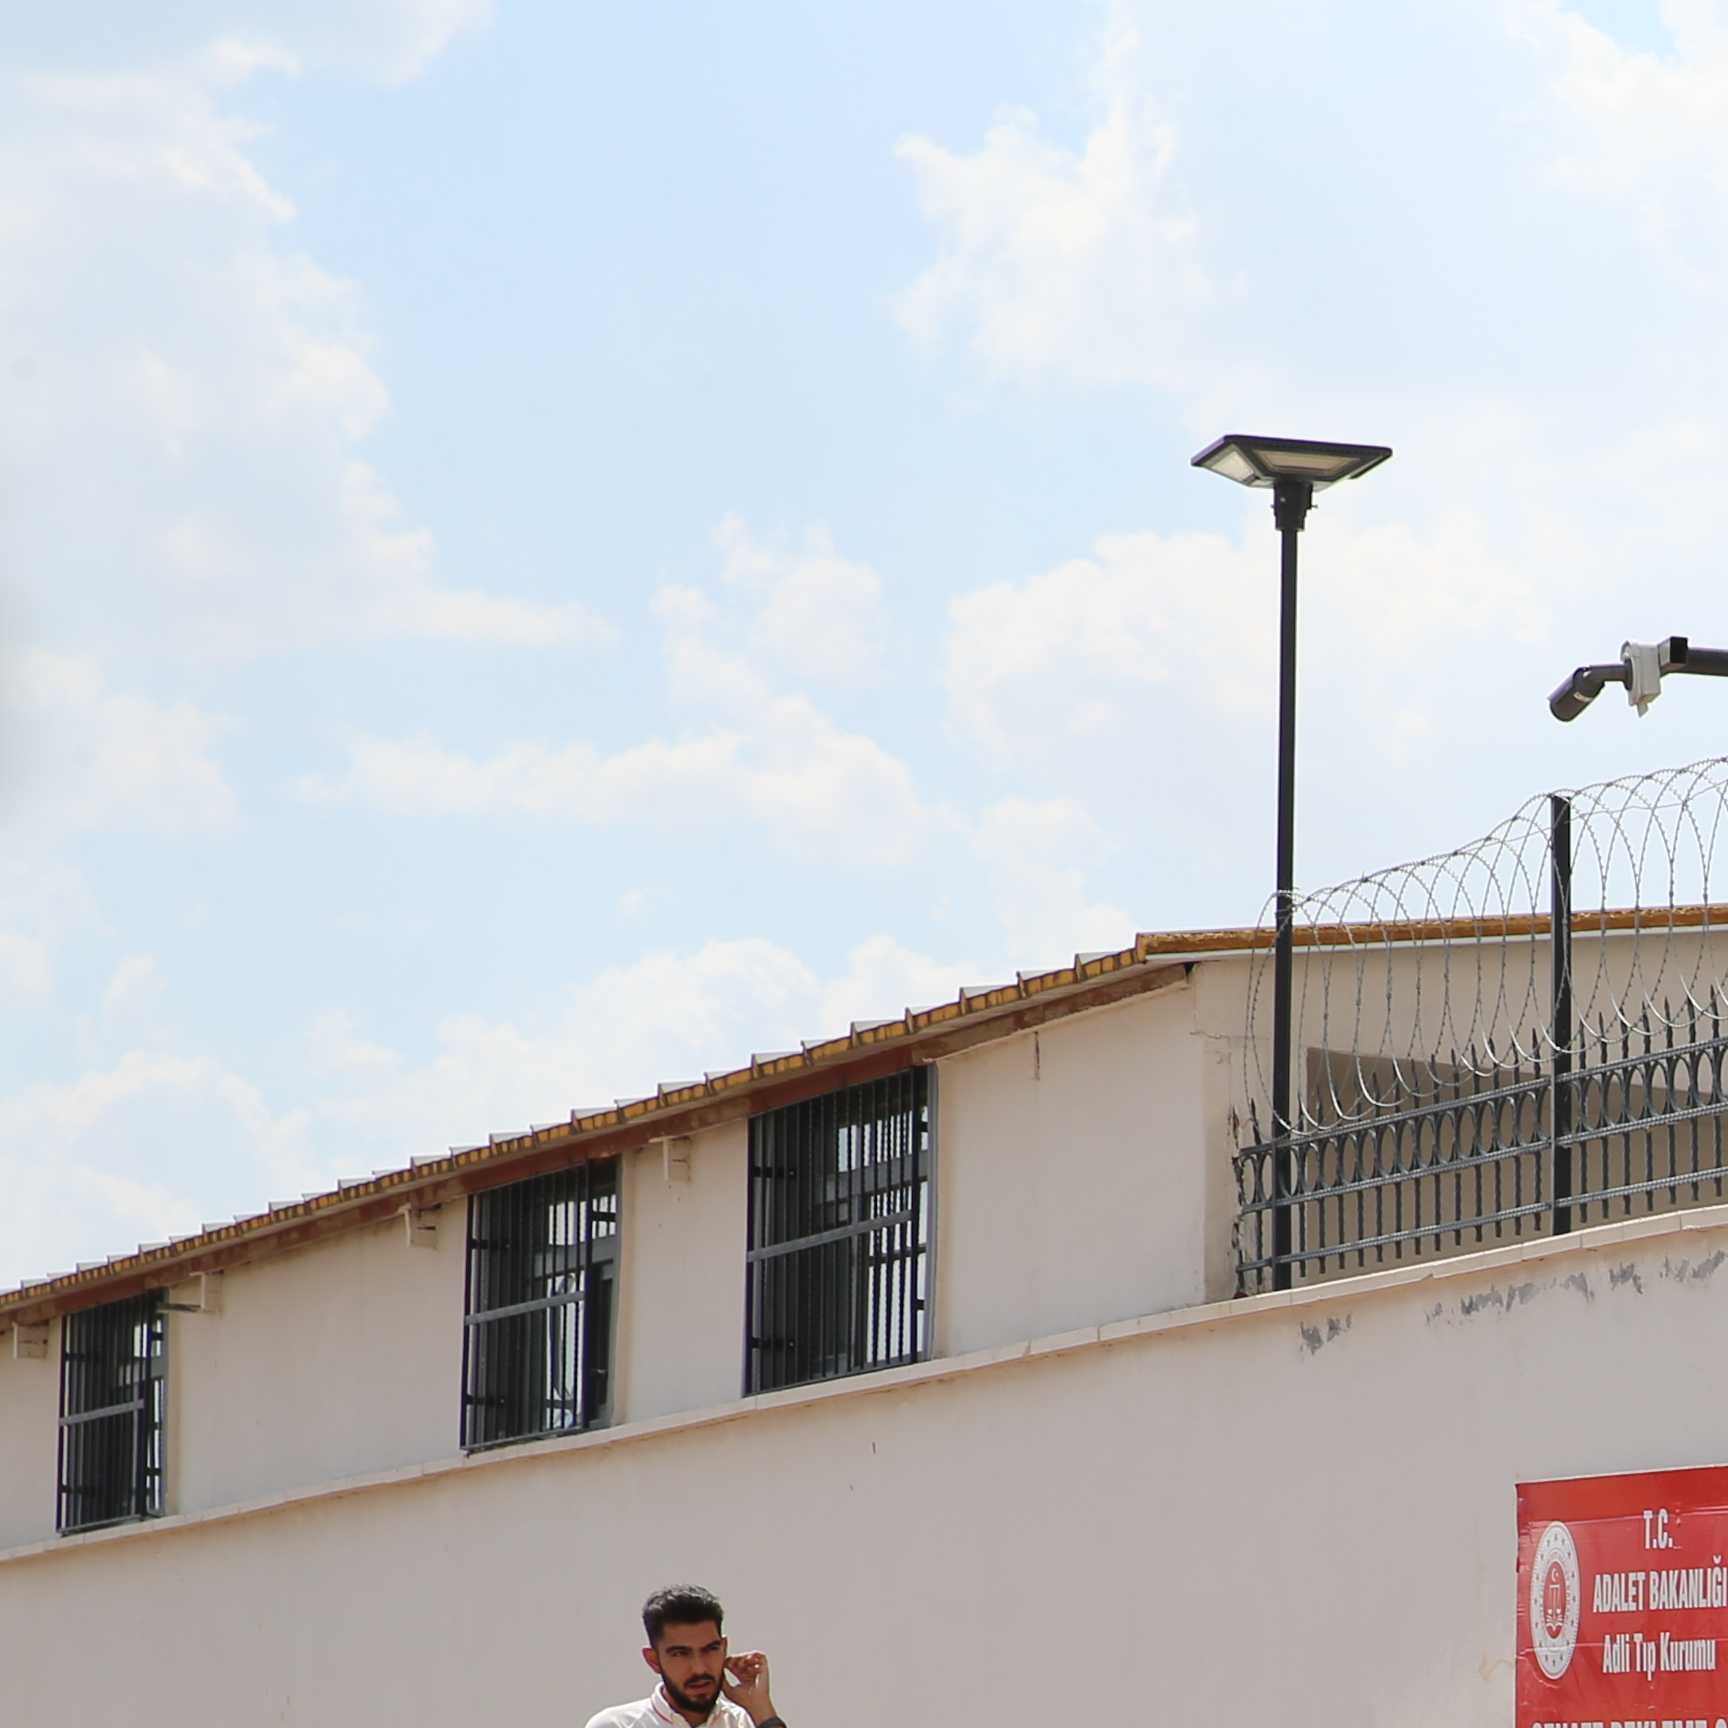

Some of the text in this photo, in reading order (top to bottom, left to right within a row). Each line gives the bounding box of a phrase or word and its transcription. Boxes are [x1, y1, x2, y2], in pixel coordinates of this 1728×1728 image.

[1642, 1508, 1673, 1549] T.C.
[1592, 1571, 1646, 1613] ADALET
[1649, 1555, 1728, 1610] BAKANLIĞI
[1603, 1632, 1716, 1681] Adli Tıp Kurumu
